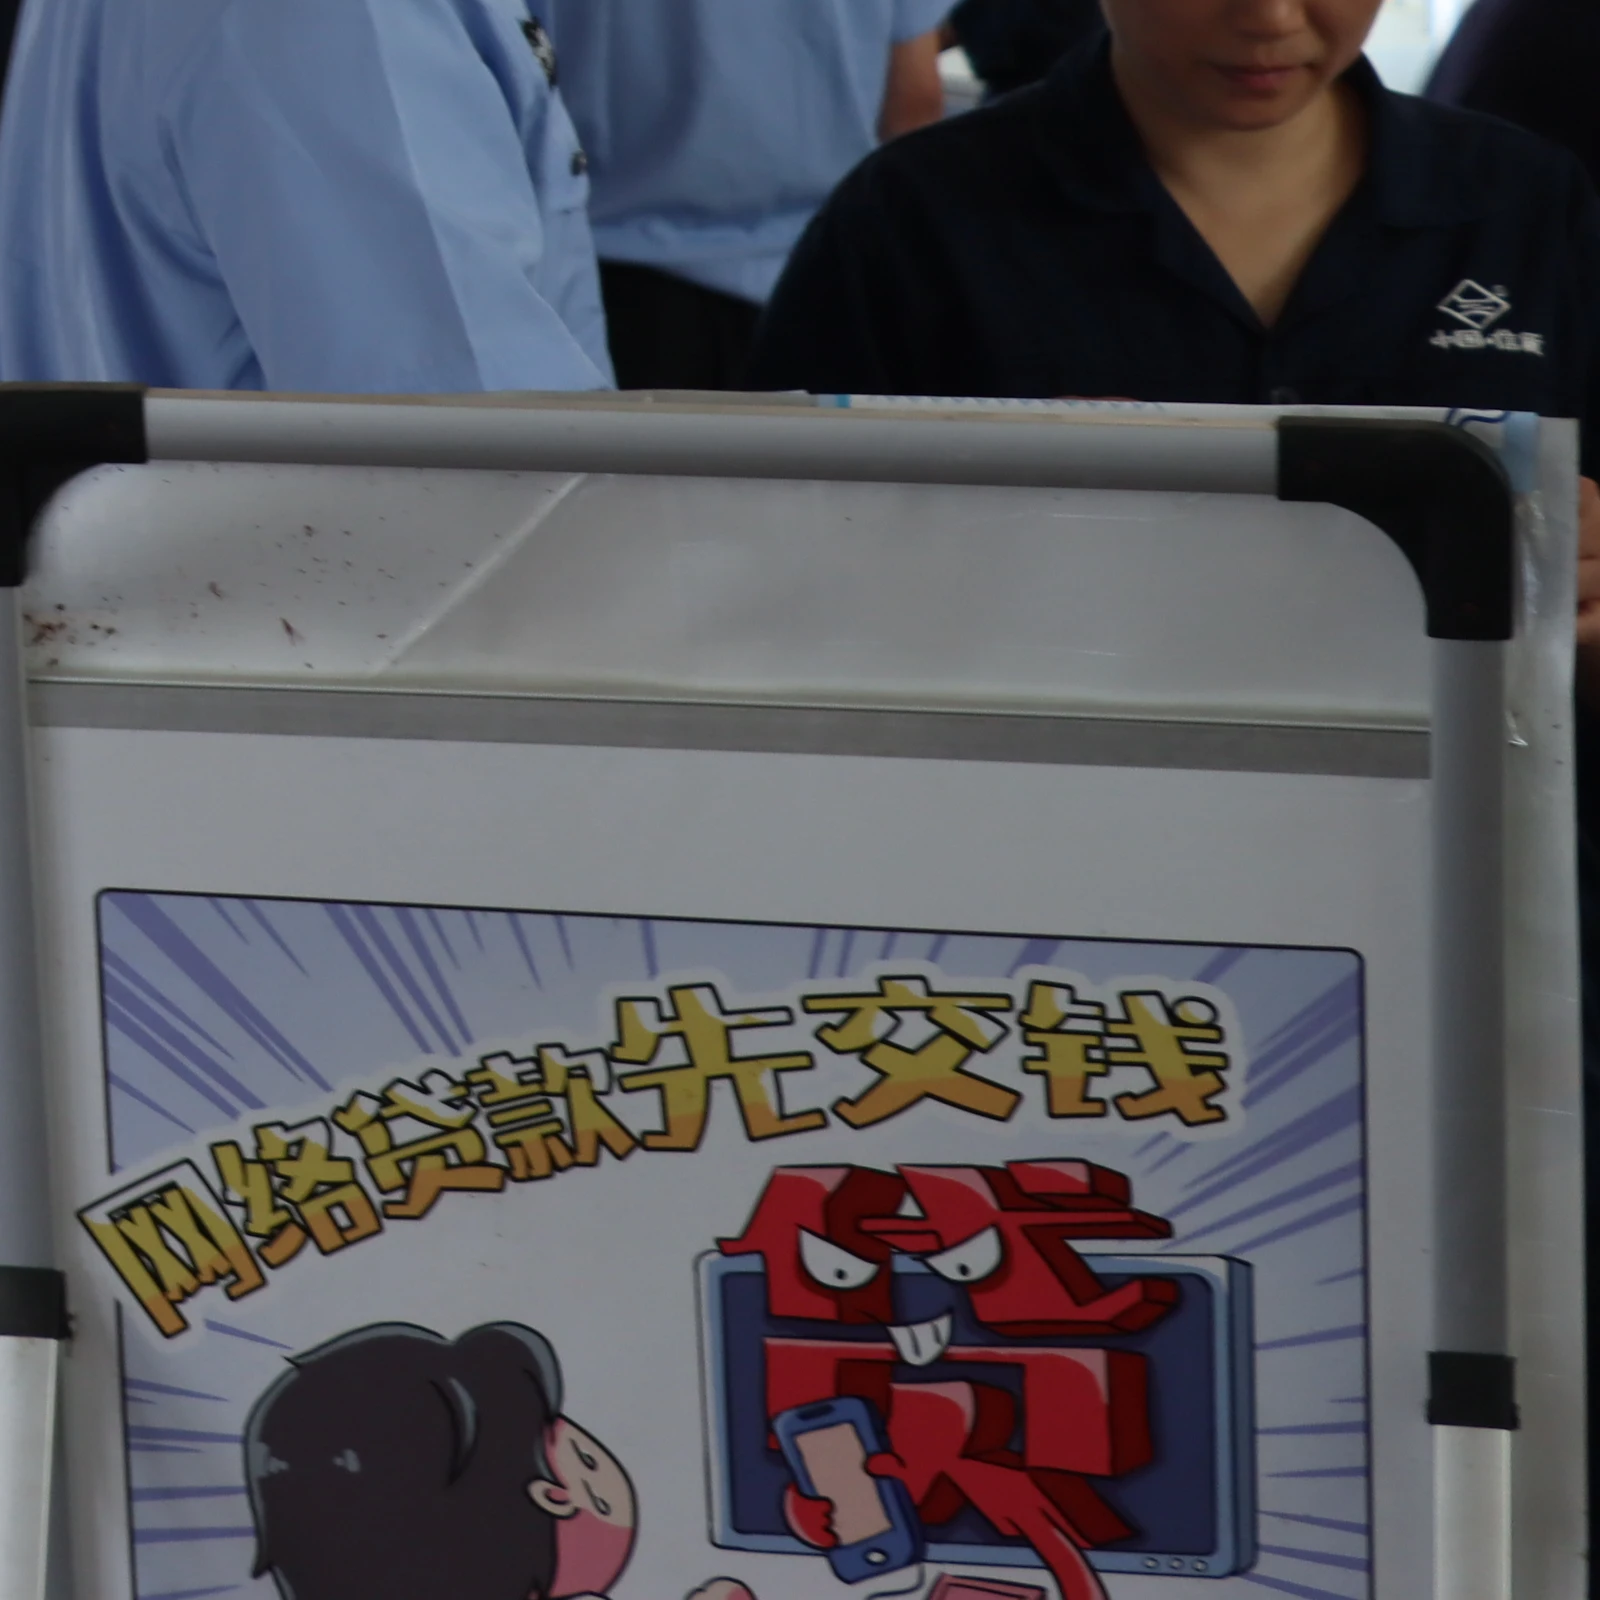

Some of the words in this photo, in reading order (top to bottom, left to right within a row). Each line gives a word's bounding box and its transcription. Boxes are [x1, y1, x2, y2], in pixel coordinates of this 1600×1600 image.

[77, 975, 1230, 1338] 网络贷款先交钱
